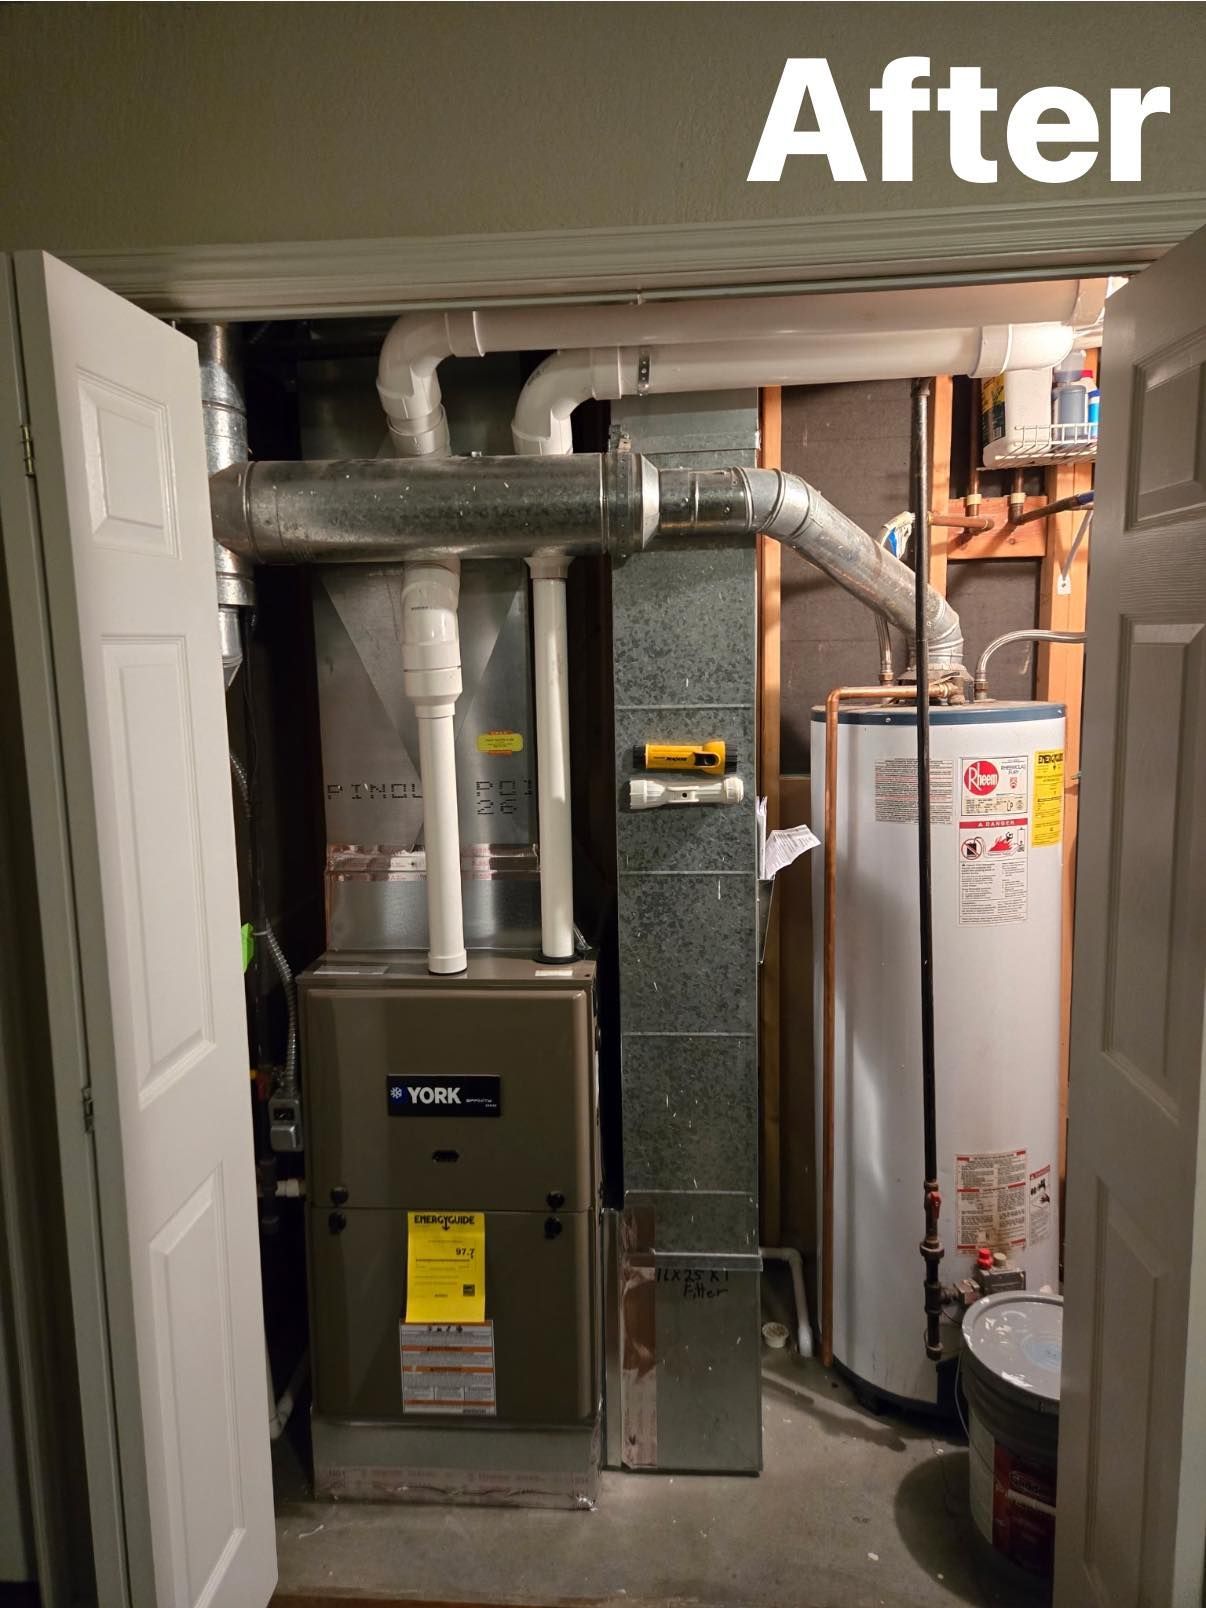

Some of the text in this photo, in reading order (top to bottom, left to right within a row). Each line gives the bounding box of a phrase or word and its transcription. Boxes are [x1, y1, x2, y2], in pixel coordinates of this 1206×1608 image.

[968, 762, 998, 791] Rheem
[476, 799, 518, 815] 26
[985, 819, 1015, 828] DANGER
[407, 1087, 462, 1104] YORK
[414, 1215, 475, 1225] ENERGYGUIDE
[682, 1280, 729, 1299] Filter
